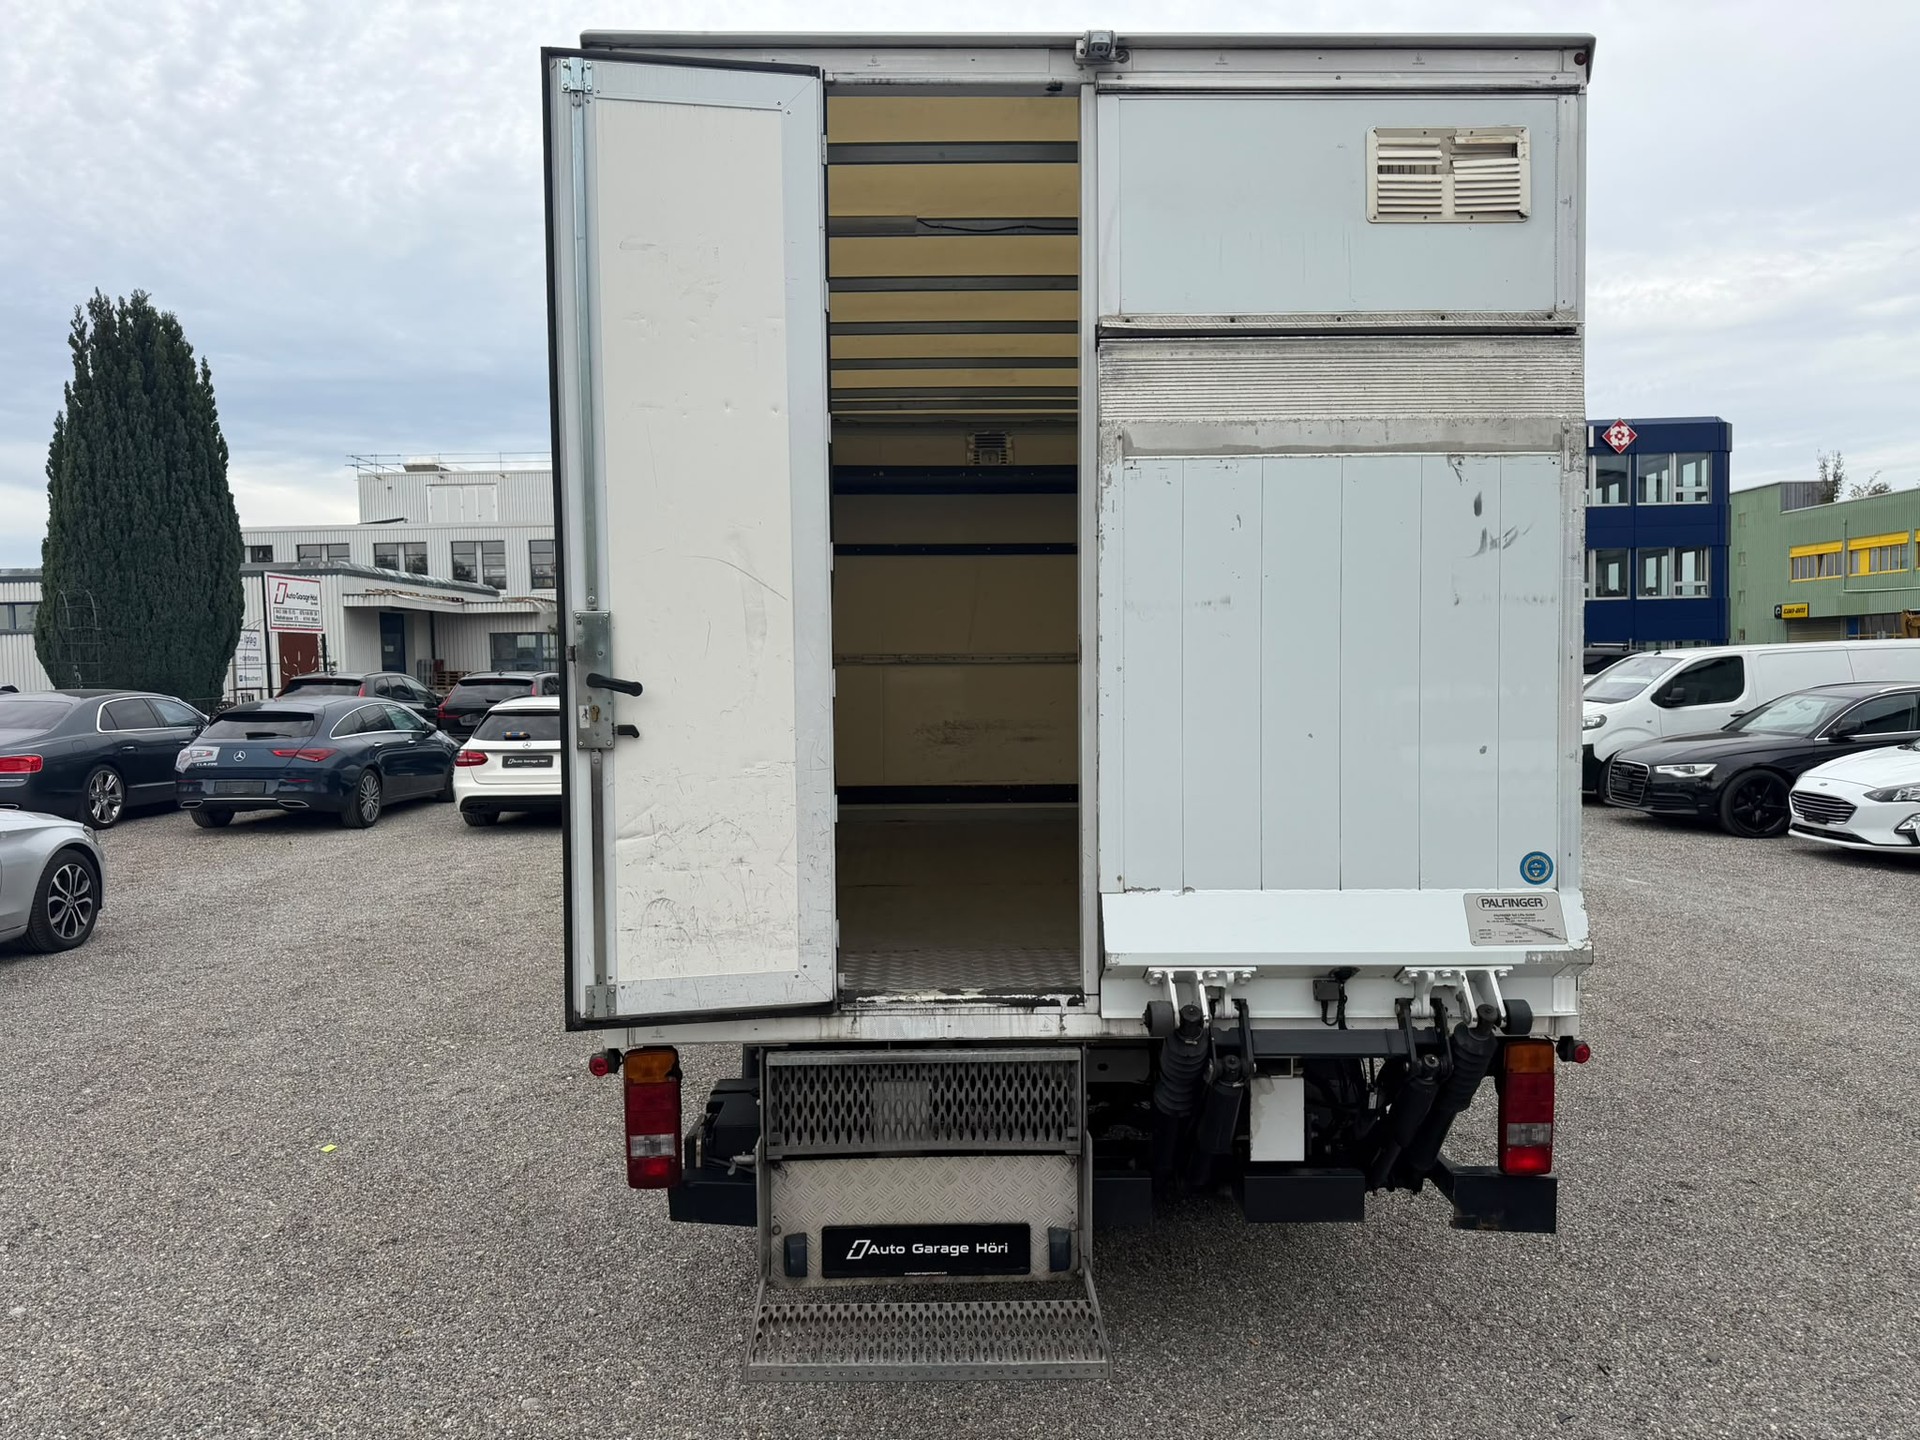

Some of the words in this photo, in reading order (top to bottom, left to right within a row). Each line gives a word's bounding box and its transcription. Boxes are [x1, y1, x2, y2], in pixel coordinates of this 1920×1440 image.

[1481, 898, 1543, 907] PALFINGER
[868, 1244, 906, 1255] Auto
[912, 1243, 970, 1257] Garage
[976, 1242, 1009, 1254] Höri
